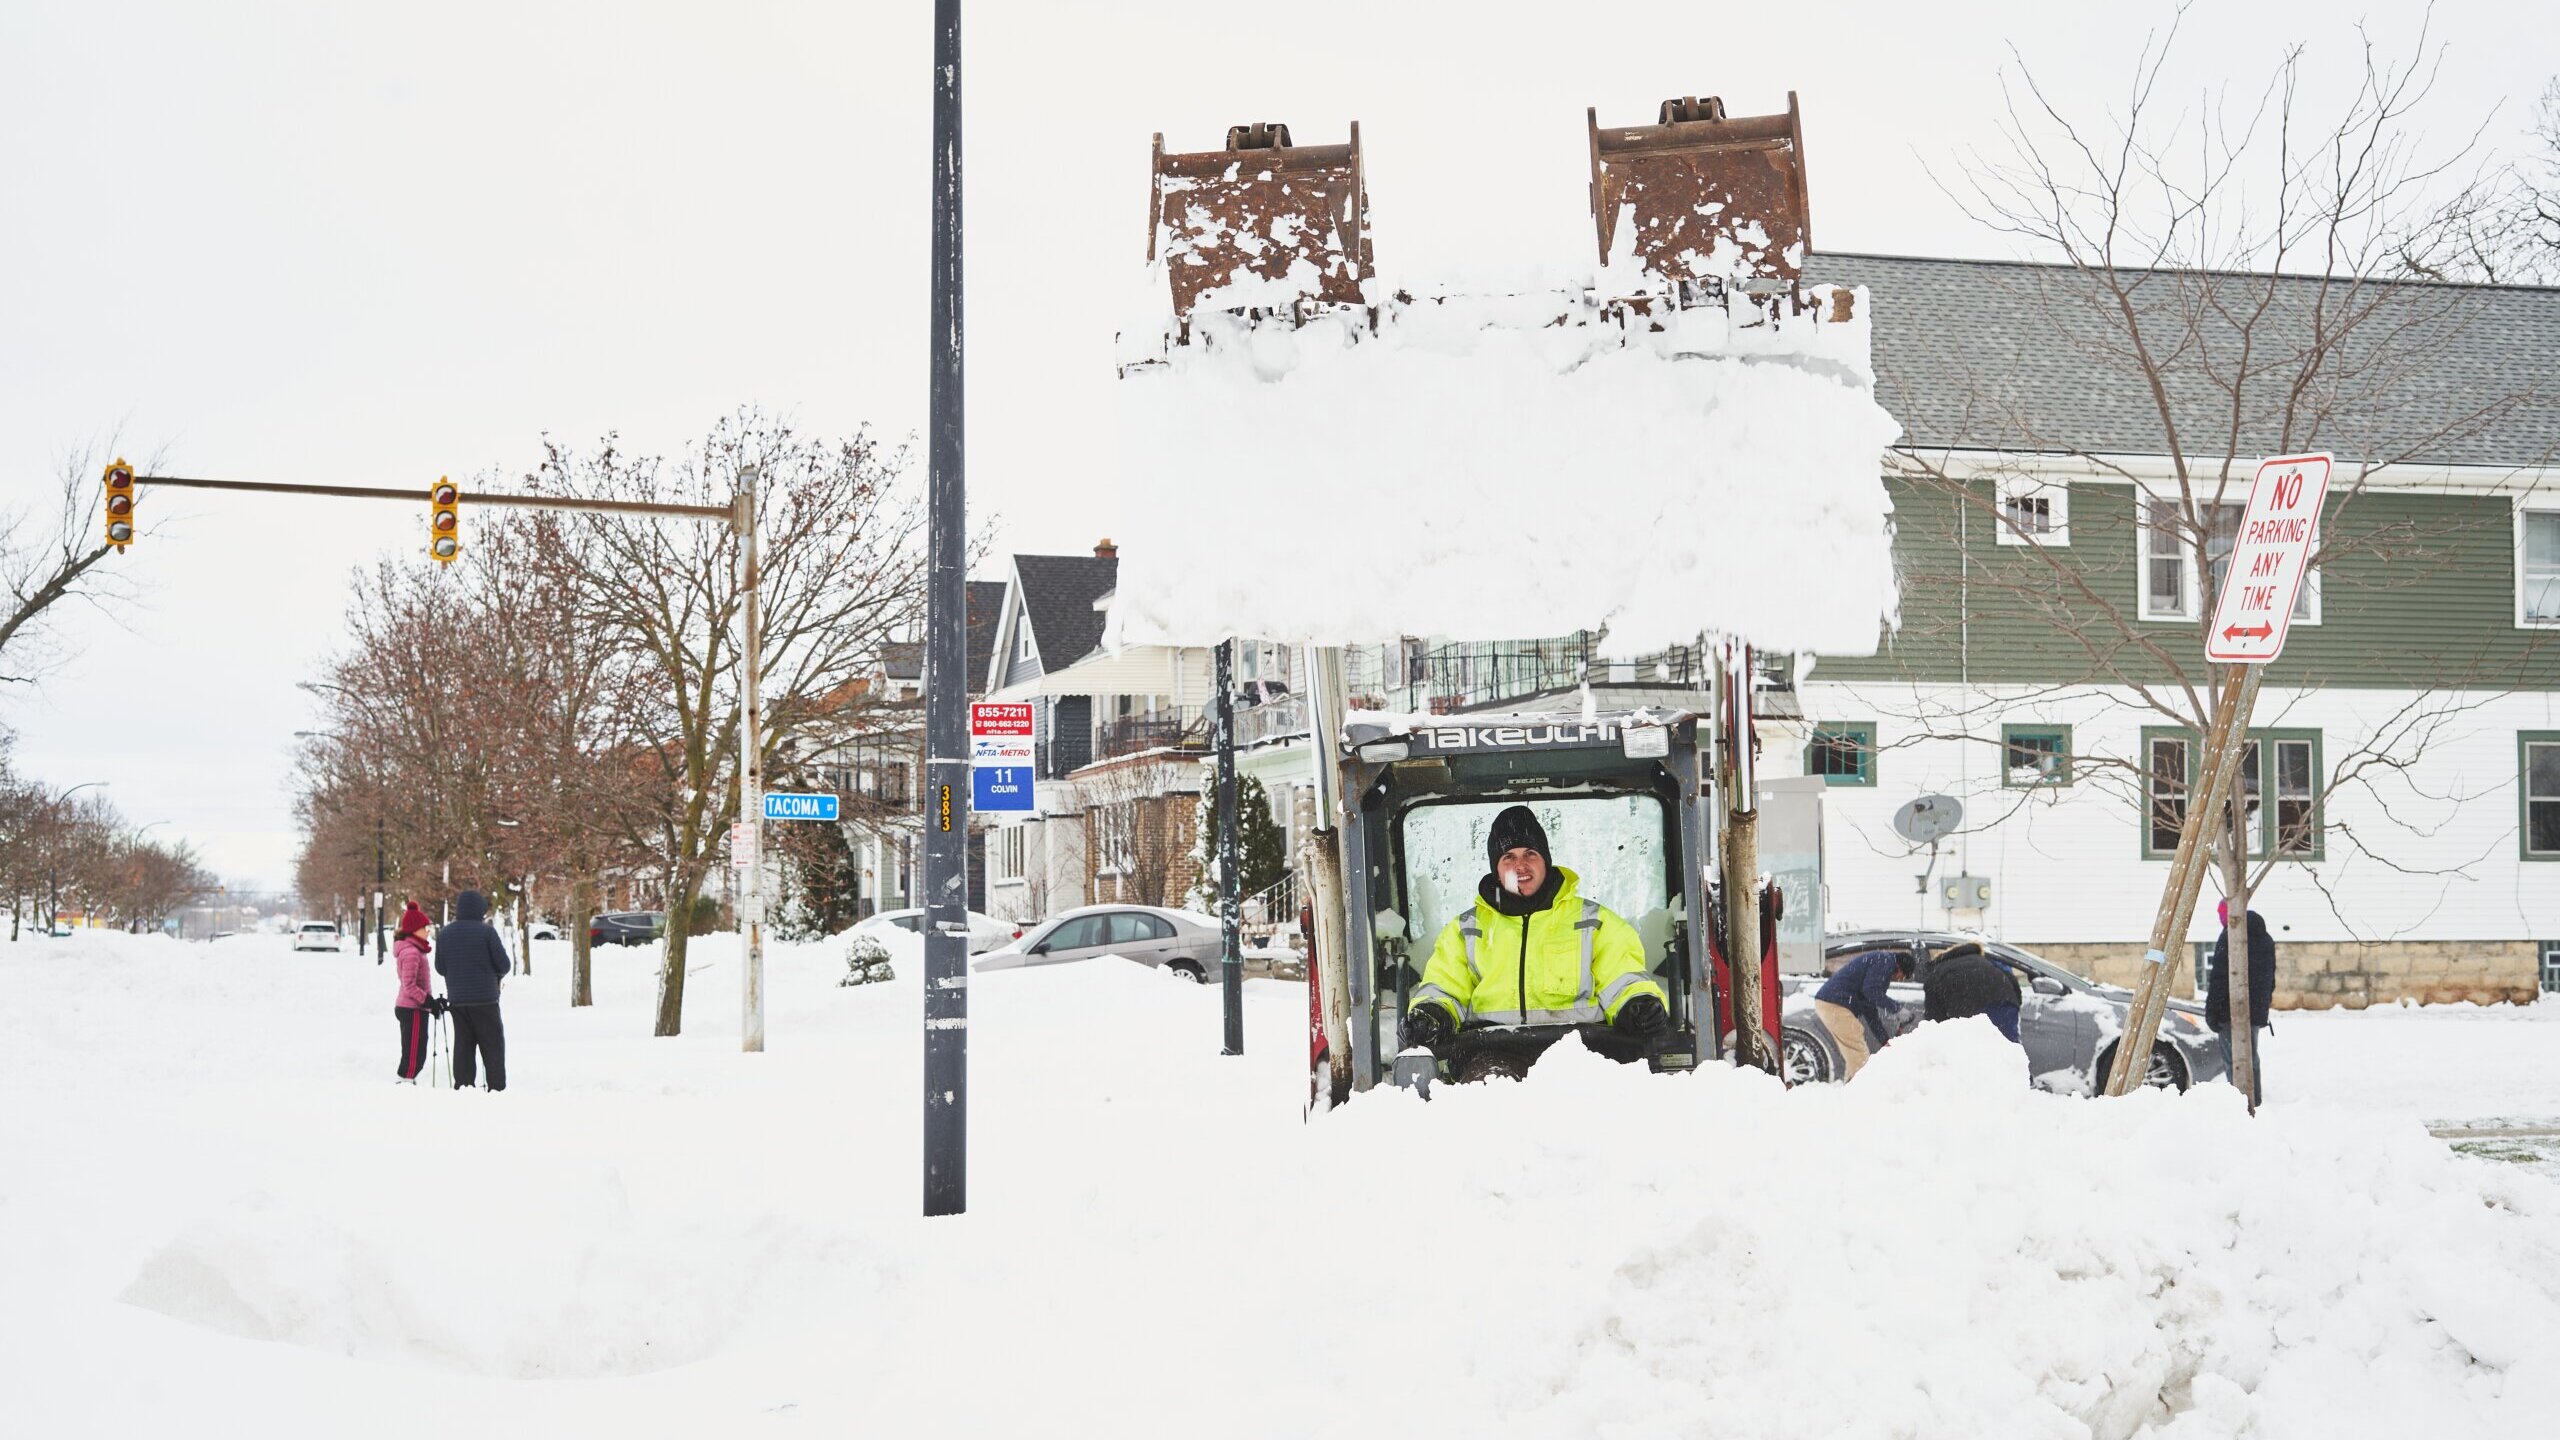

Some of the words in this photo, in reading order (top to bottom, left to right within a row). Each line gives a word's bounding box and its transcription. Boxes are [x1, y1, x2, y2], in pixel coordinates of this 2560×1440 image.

[2269, 473, 2303, 511] NO
[2246, 518, 2307, 545] PARKING
[2250, 551, 2285, 577] ANY
[2241, 585, 2277, 611] TIME
[978, 707, 1027, 718] 855-7211
[976, 749, 1030, 757] NFTA-METRO
[995, 768, 1012, 783] 11
[991, 785, 1018, 793] COLVIN
[766, 797, 820, 816] TACOMA
[942, 786, 950, 831] 383
